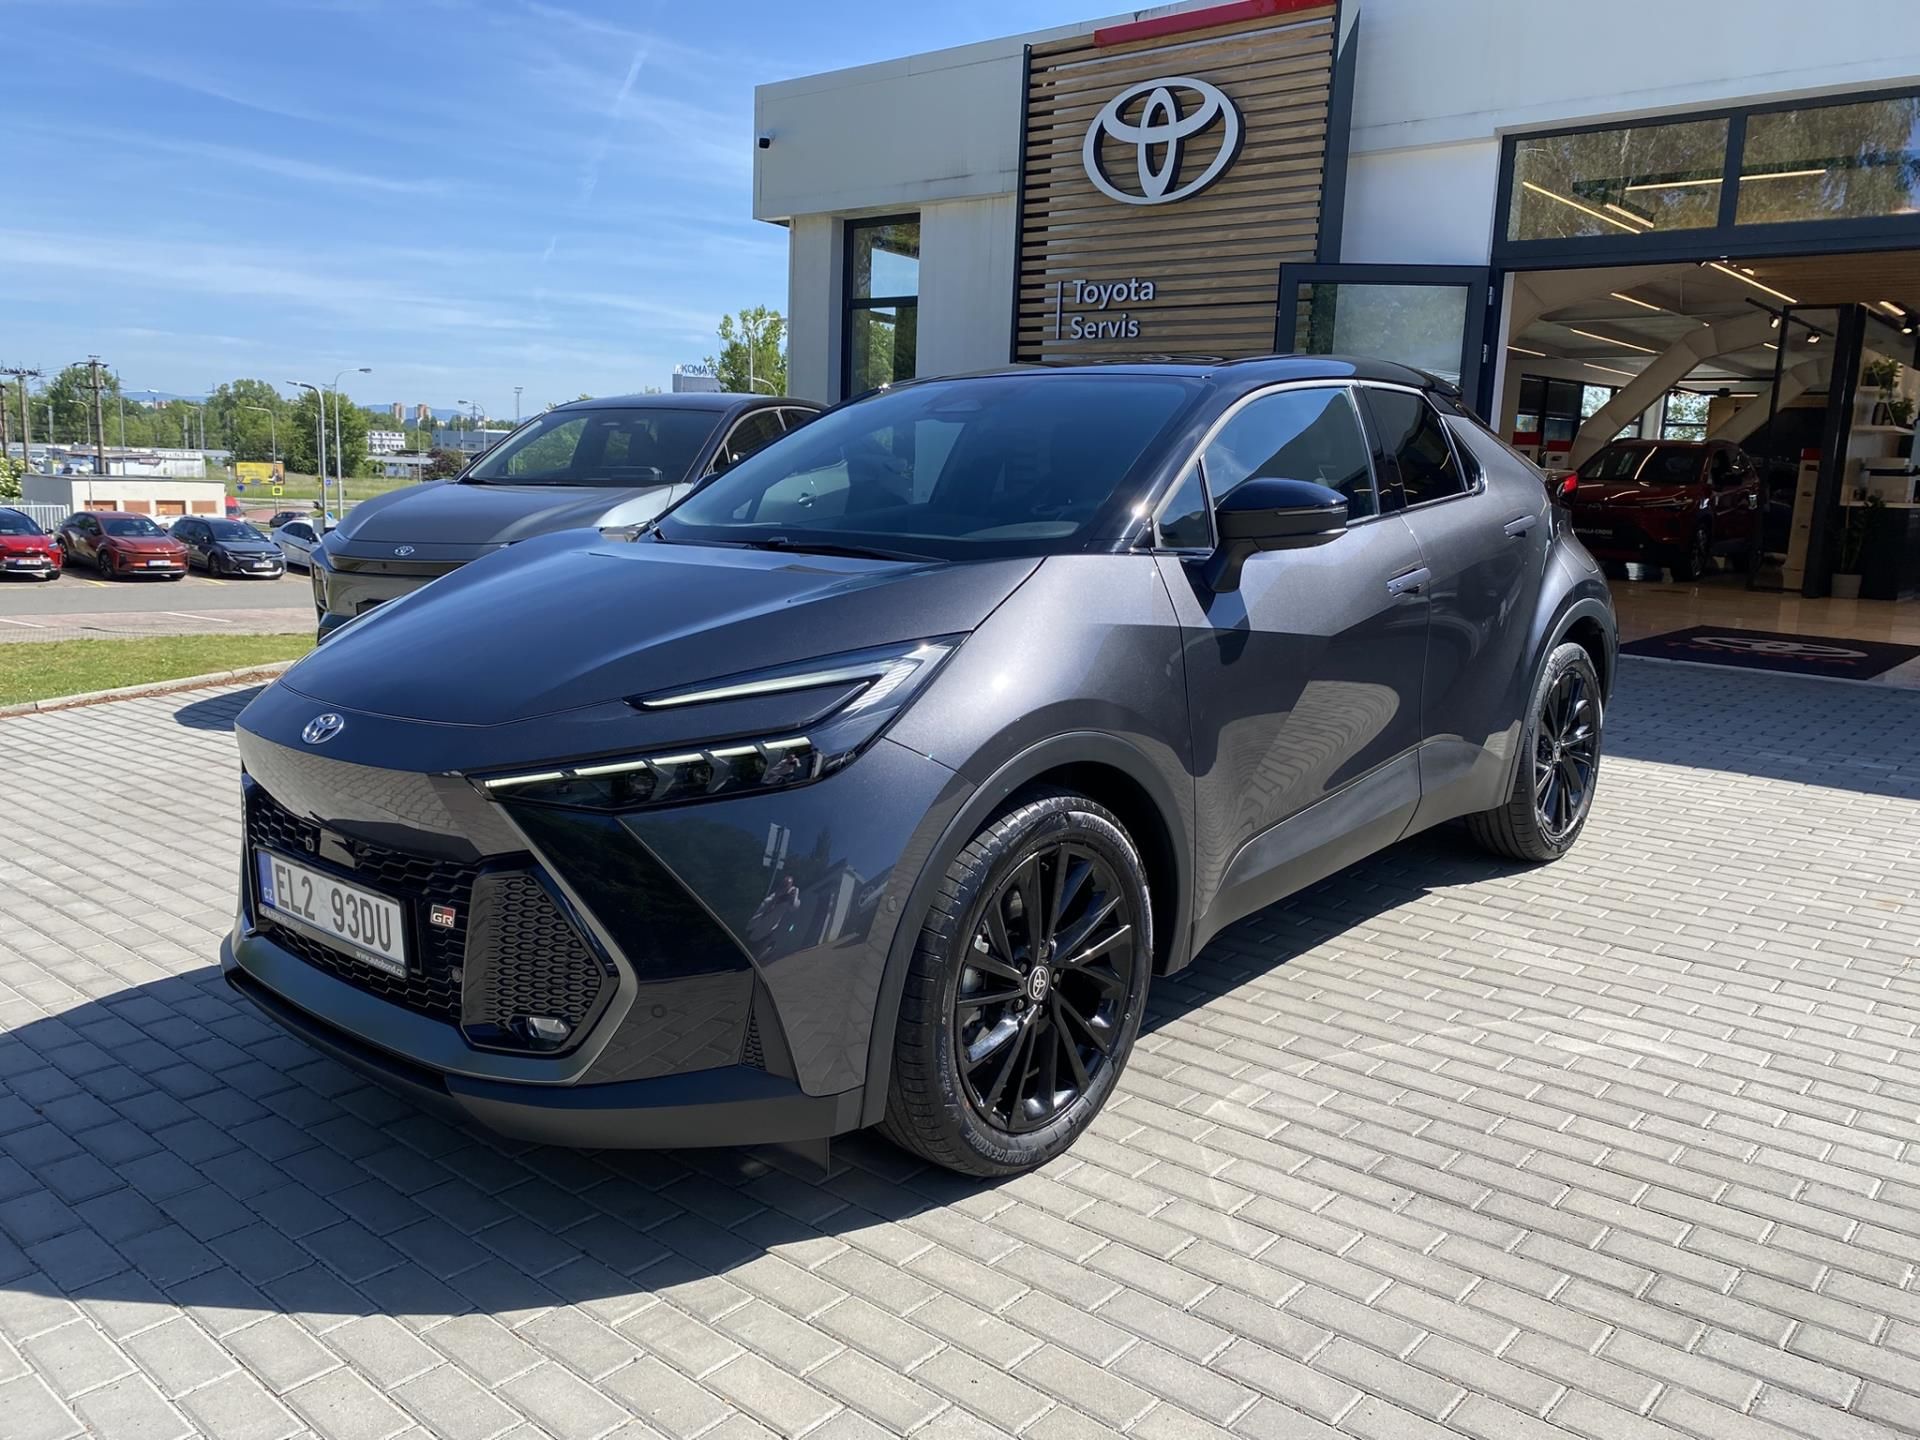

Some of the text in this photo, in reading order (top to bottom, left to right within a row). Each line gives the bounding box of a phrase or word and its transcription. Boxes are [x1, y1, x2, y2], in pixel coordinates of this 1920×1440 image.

[1072, 278, 1155, 310] Toyota
[1070, 313, 1139, 339] Servis
[263, 887, 273, 901] CZ
[275, 863, 315, 921] EL2
[331, 887, 392, 952] 93DU
[432, 912, 453, 926] GR
